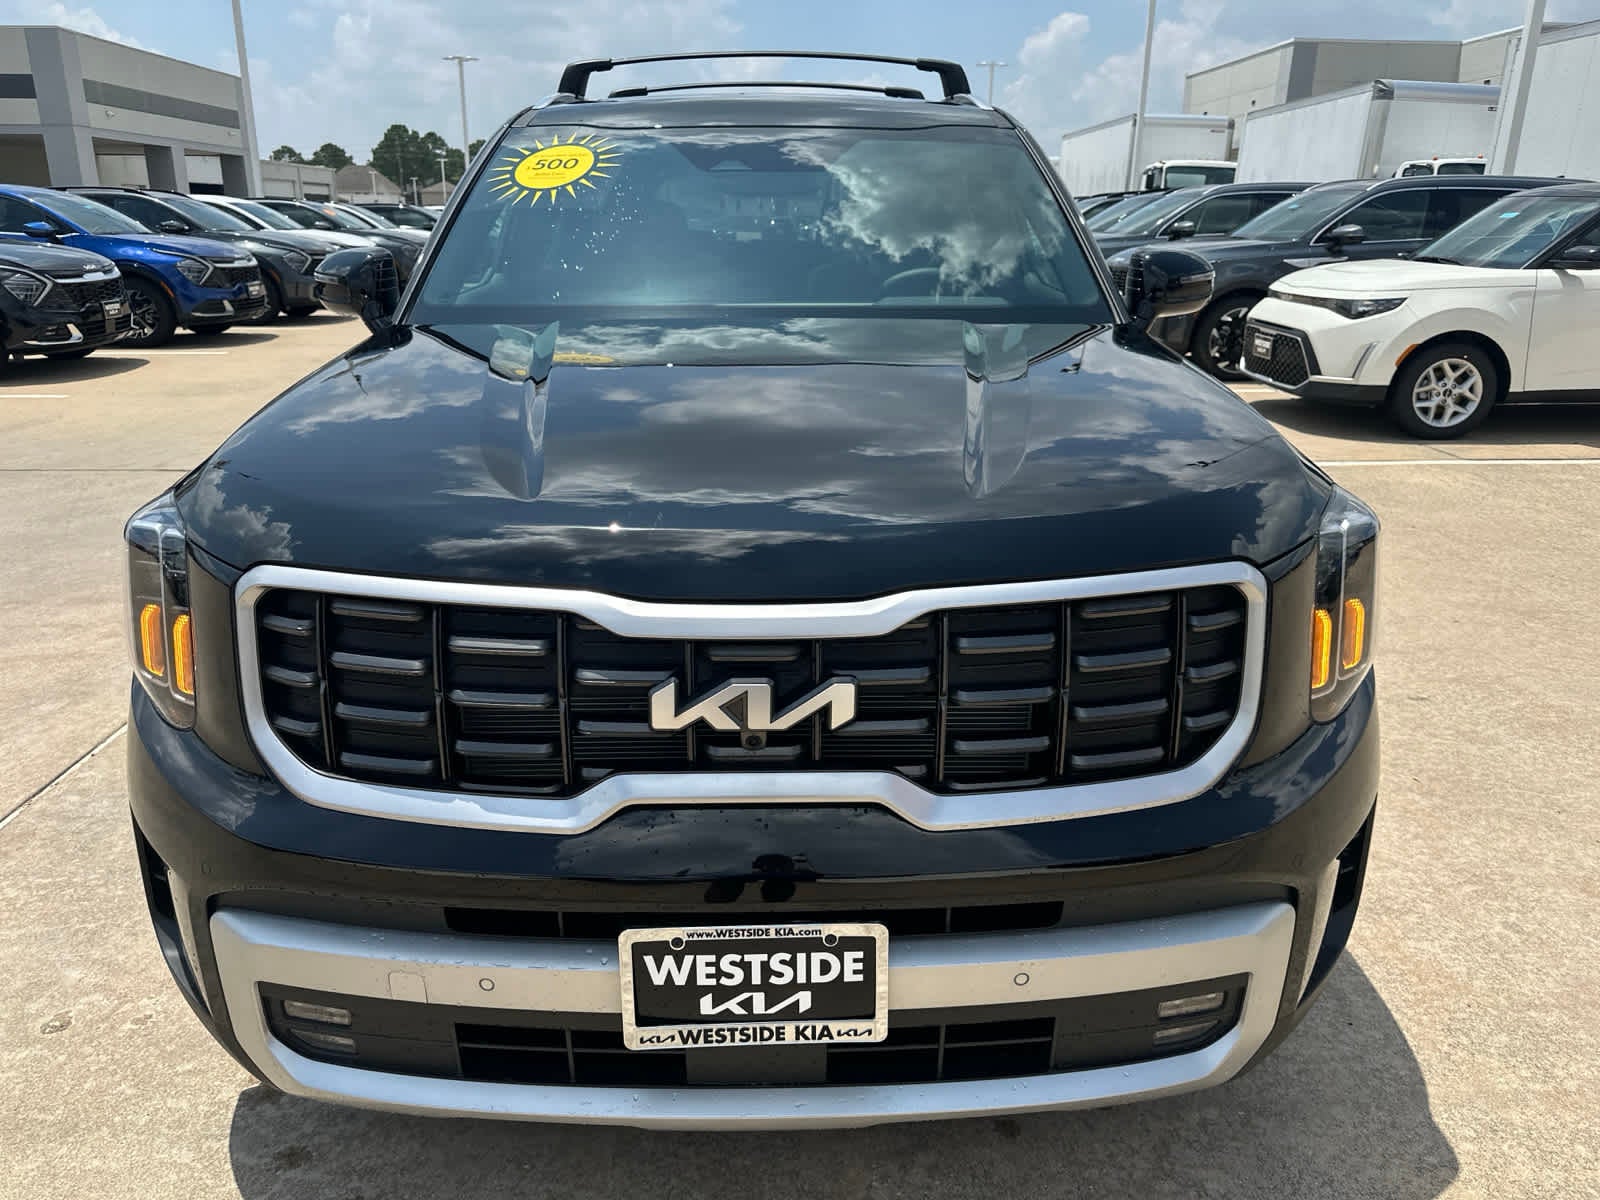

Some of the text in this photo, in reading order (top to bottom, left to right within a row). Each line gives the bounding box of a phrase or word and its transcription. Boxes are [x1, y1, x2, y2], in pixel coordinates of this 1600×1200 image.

[532, 158, 579, 170] 500
[650, 677, 856, 730] KIA
[686, 928, 822, 939] www.WESTSIDE KIA.com
[643, 951, 864, 986] WESTSIDE
[699, 991, 812, 1015] KIA
[678, 1025, 786, 1045] WESTSIDE
[795, 1025, 834, 1042] KIA
